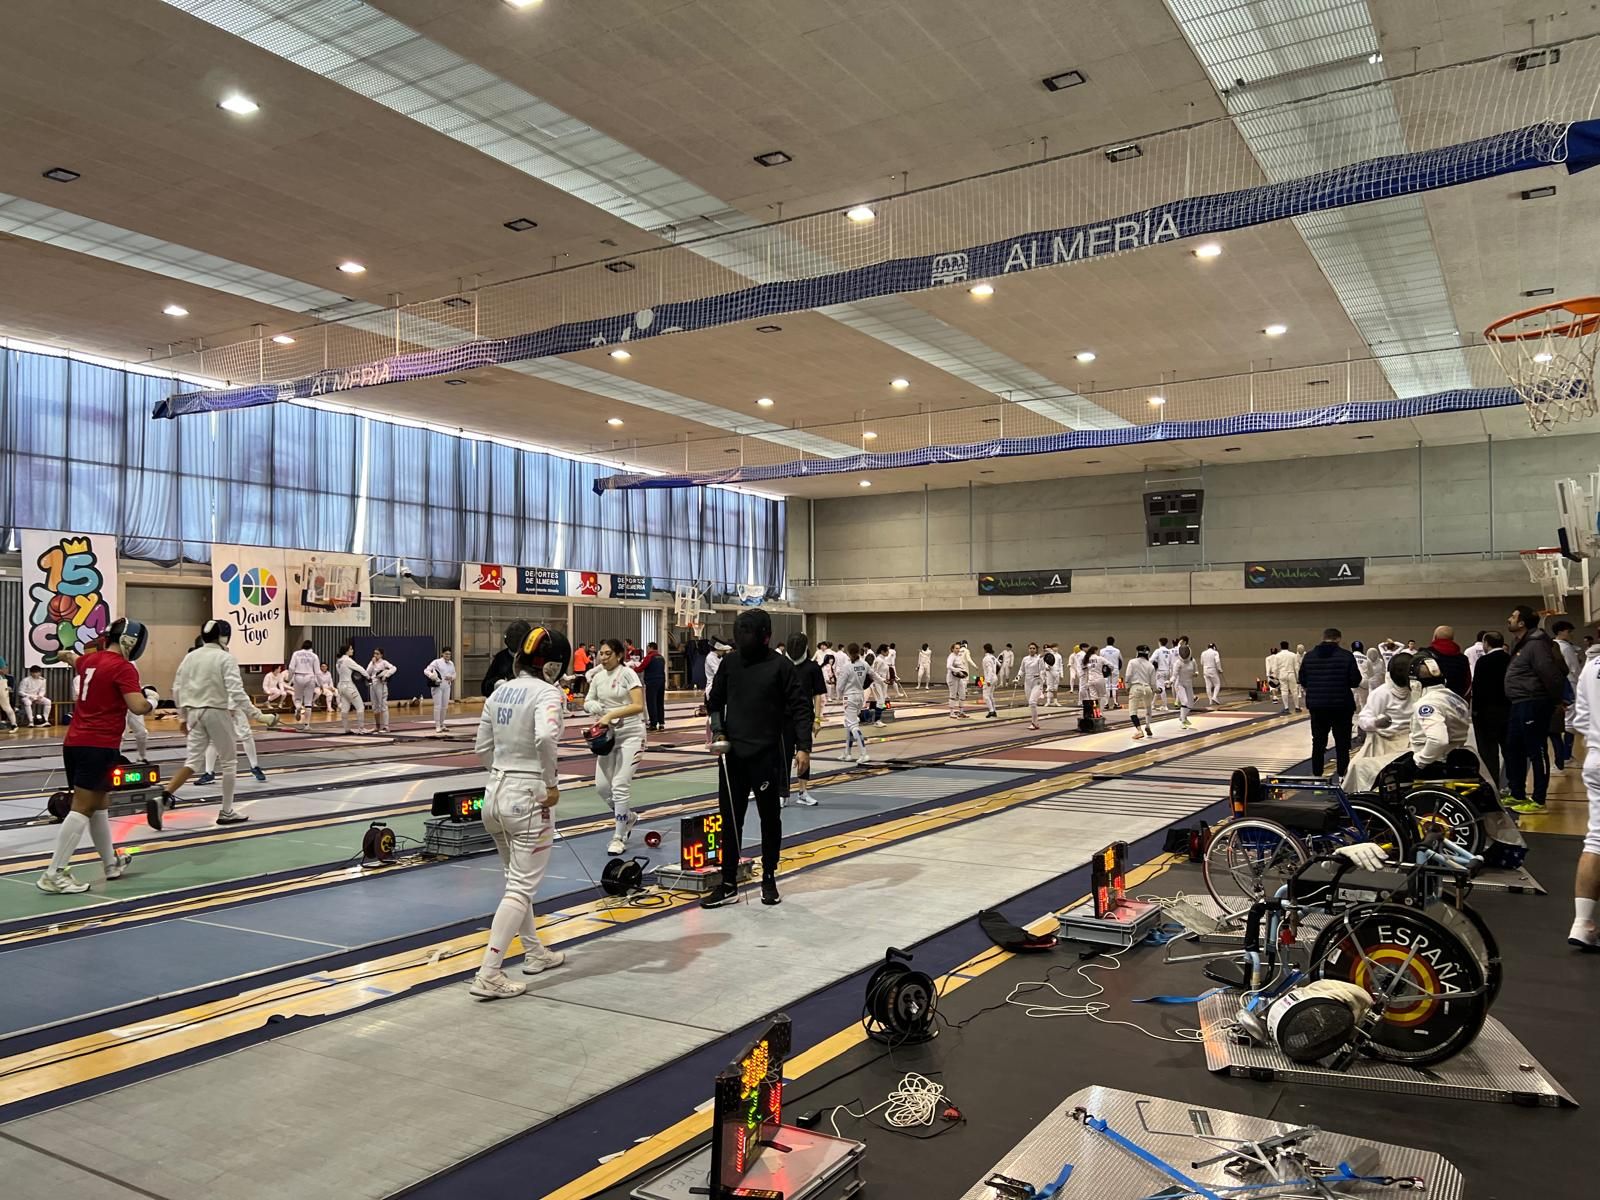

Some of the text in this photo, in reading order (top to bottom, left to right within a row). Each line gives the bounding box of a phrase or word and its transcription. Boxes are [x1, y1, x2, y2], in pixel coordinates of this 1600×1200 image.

[1003, 211, 1180, 273] ALMERÍA
[39, 547, 101, 597] 15
[228, 607, 280, 626] Vamos
[497, 706, 513, 725] ESP
[707, 833, 715, 850] 9
[683, 843, 704, 868] 45
[1378, 925, 1463, 995] ESPAÑA
